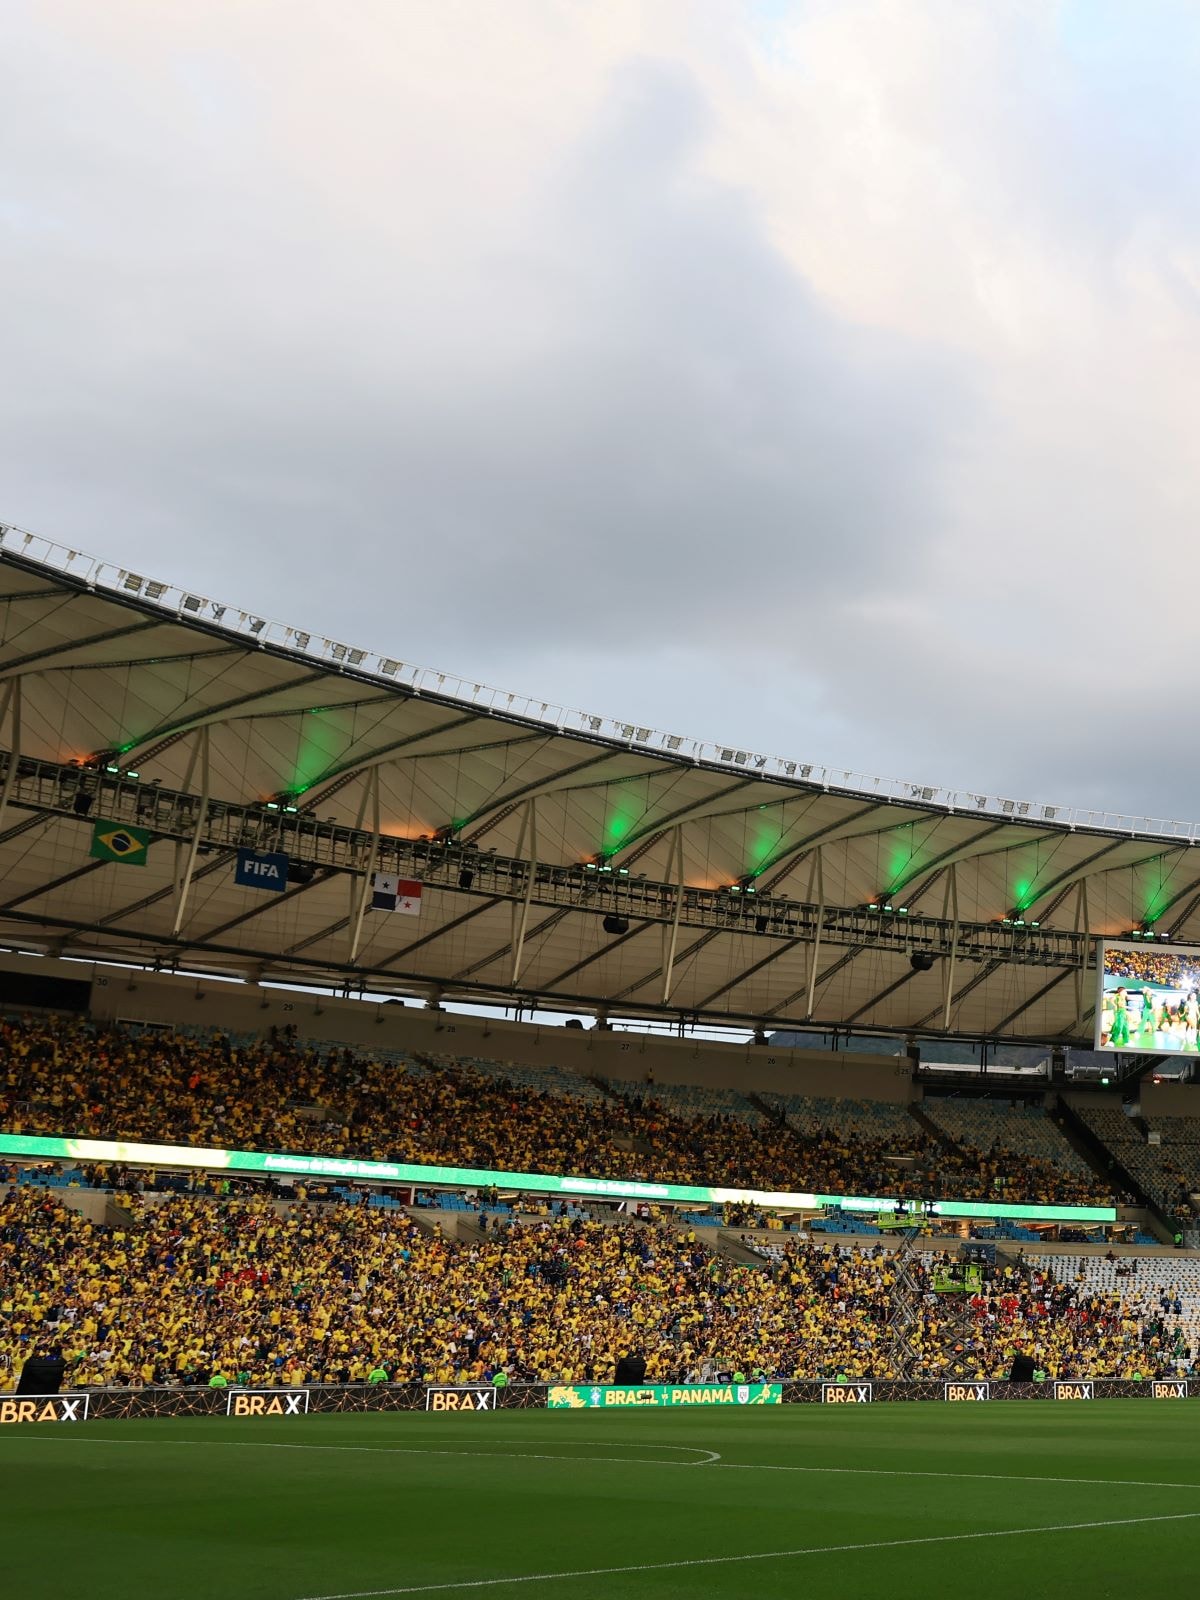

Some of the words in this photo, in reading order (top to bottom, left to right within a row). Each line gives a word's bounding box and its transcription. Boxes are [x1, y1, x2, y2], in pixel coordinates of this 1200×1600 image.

[244, 860, 279, 878] FIFA
[605, 1389, 658, 1405] BRASIL
[672, 1385, 733, 1404] PANAMÁ
[827, 1388, 867, 1402] BRAX
[949, 1387, 985, 1400] BRAX
[1058, 1385, 1090, 1399] BRAX
[1155, 1384, 1184, 1398] BRAX
[235, 1395, 302, 1415] BRAX
[433, 1392, 489, 1410] BRAX
[0, 1400, 80, 1422] BRAX
